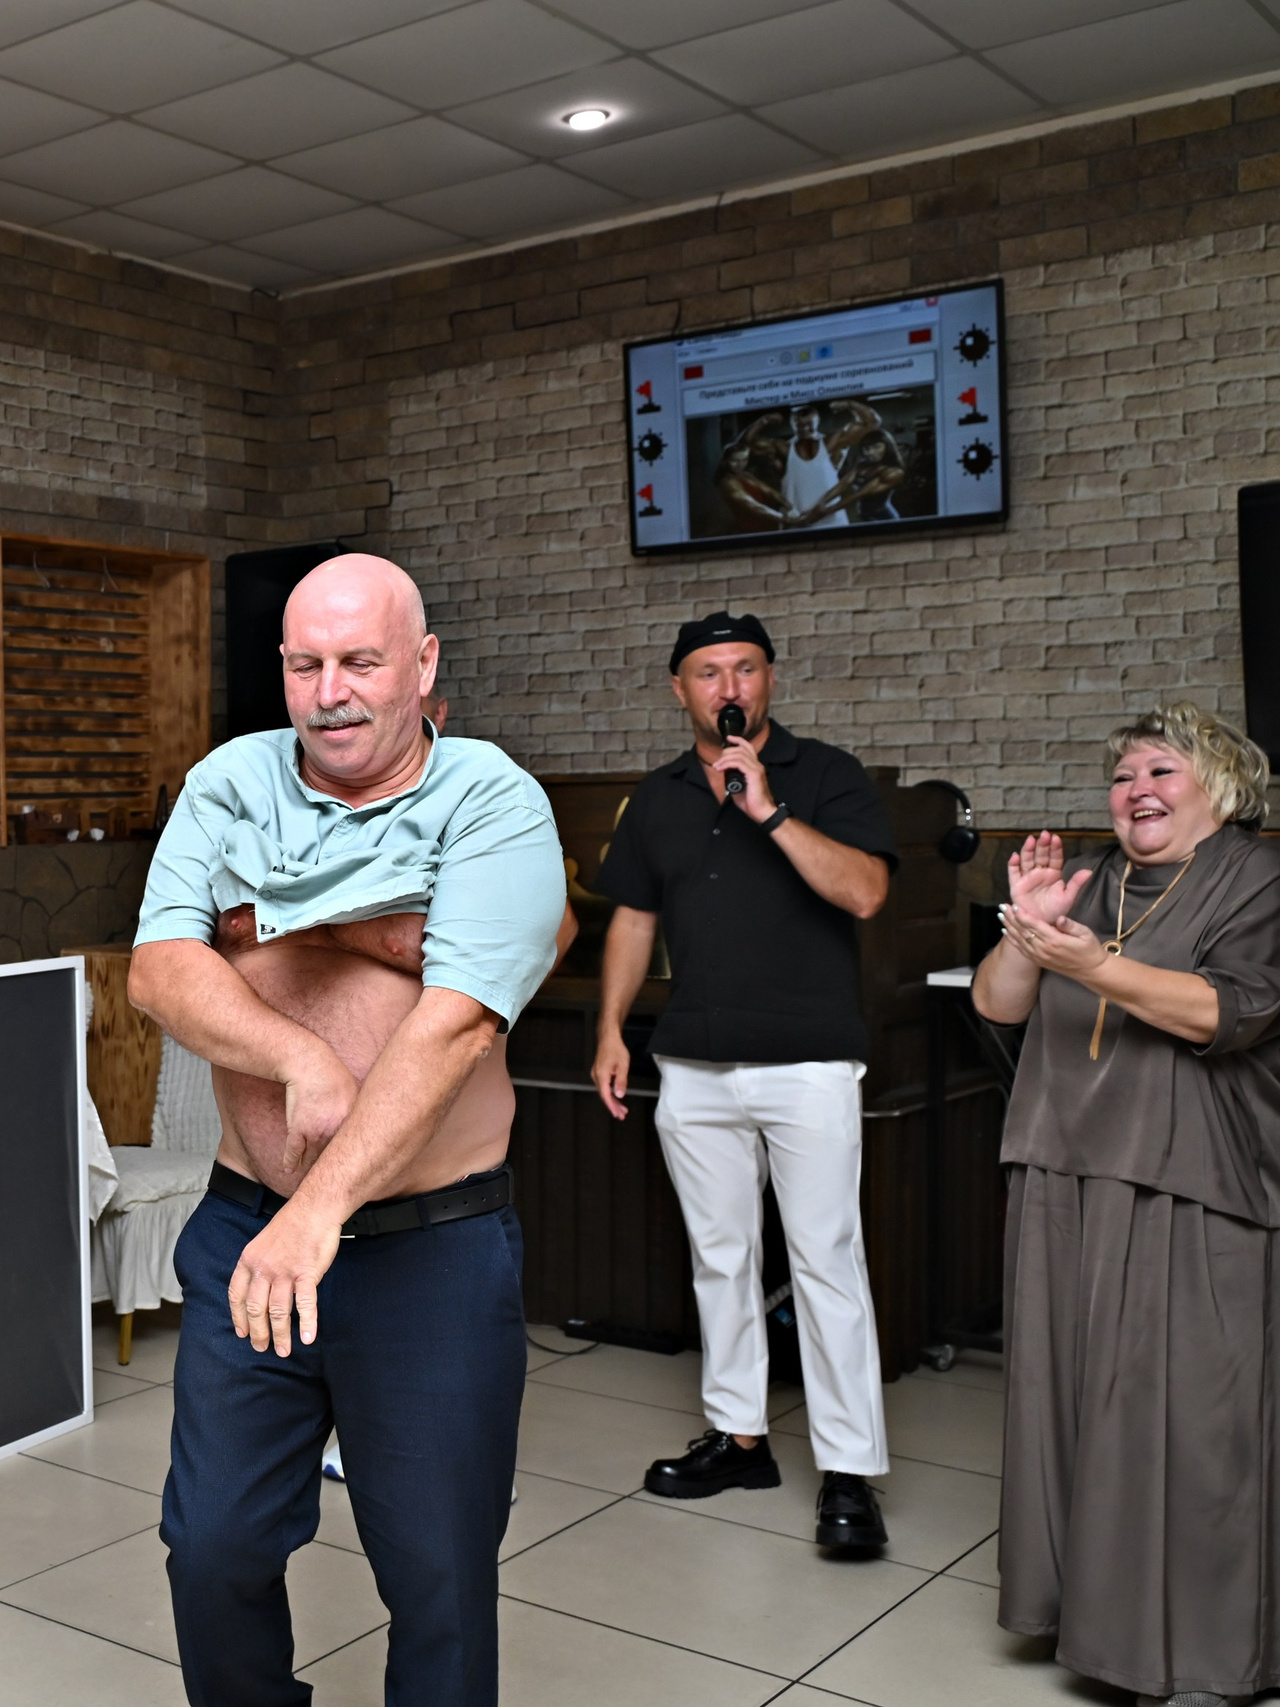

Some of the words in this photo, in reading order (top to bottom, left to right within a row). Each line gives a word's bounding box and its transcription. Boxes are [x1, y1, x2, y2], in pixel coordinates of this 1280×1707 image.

[781, 378, 793, 387] на
[795, 371, 838, 385] подиуме
[840, 359, 914, 380] соревнований
[744, 393, 779, 406] Мистер
